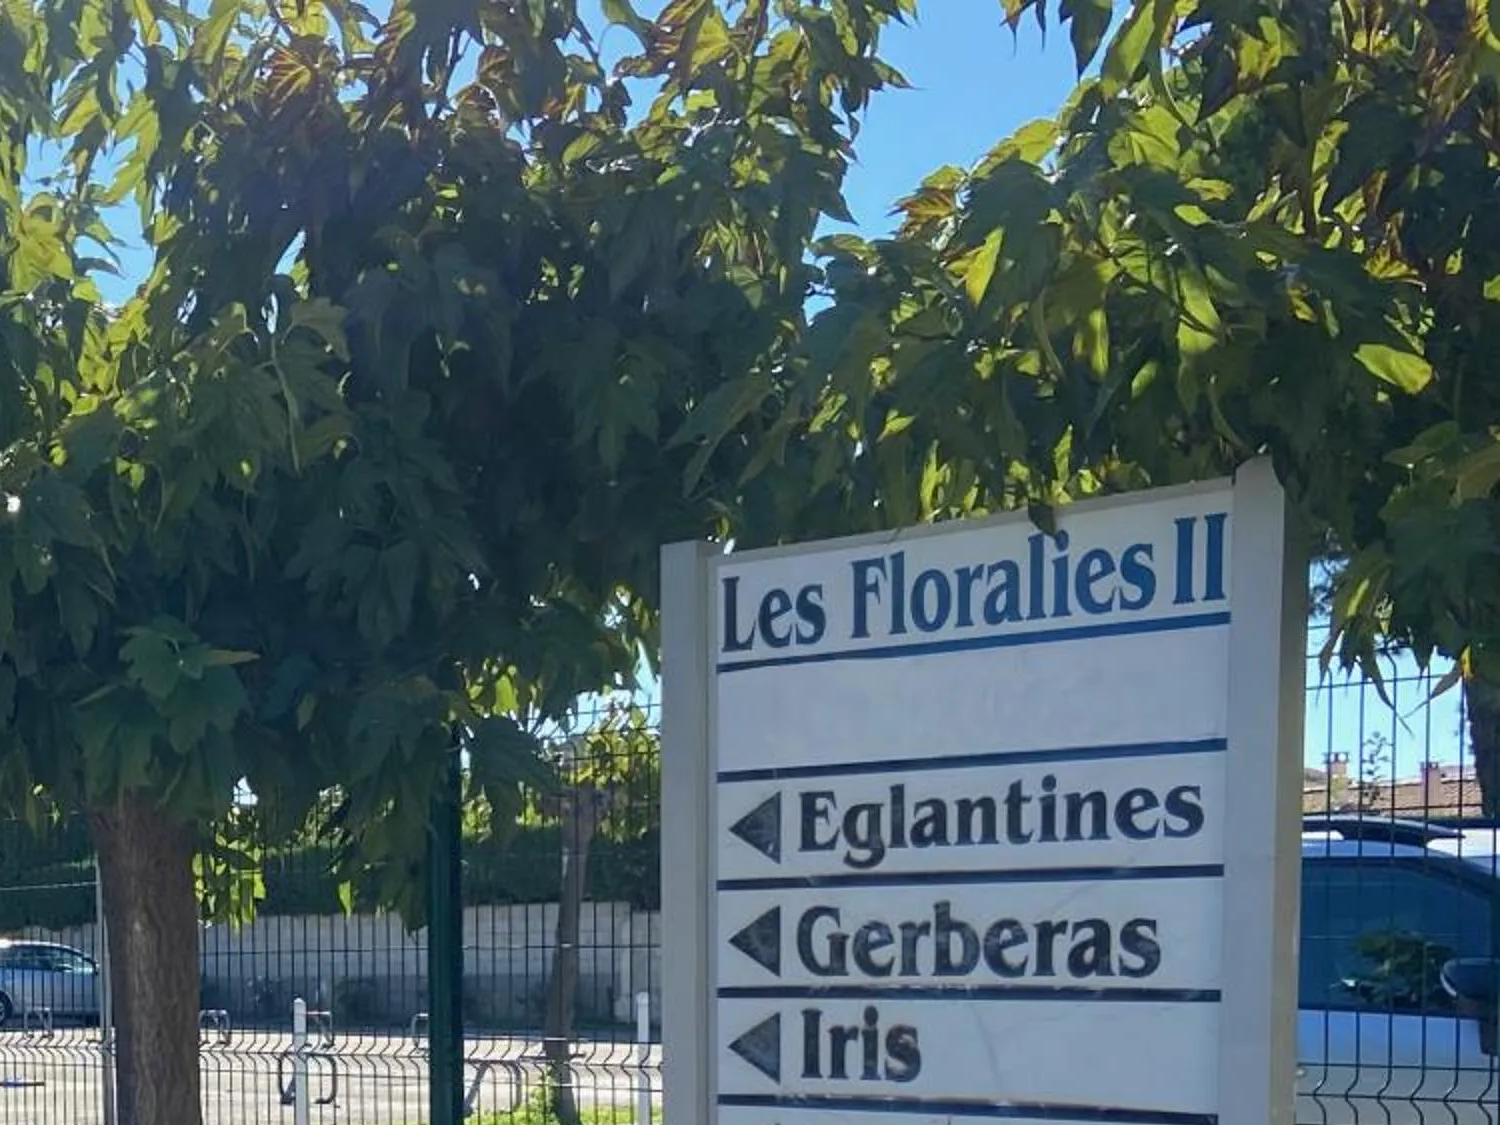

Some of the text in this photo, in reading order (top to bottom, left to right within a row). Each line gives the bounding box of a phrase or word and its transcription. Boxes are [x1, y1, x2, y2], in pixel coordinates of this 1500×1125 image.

[721, 512, 1228, 653] Les Floralies II
[799, 775, 1205, 869] Eglantines
[797, 901, 1162, 978] Gerberas
[801, 1006, 922, 1083] Iris
